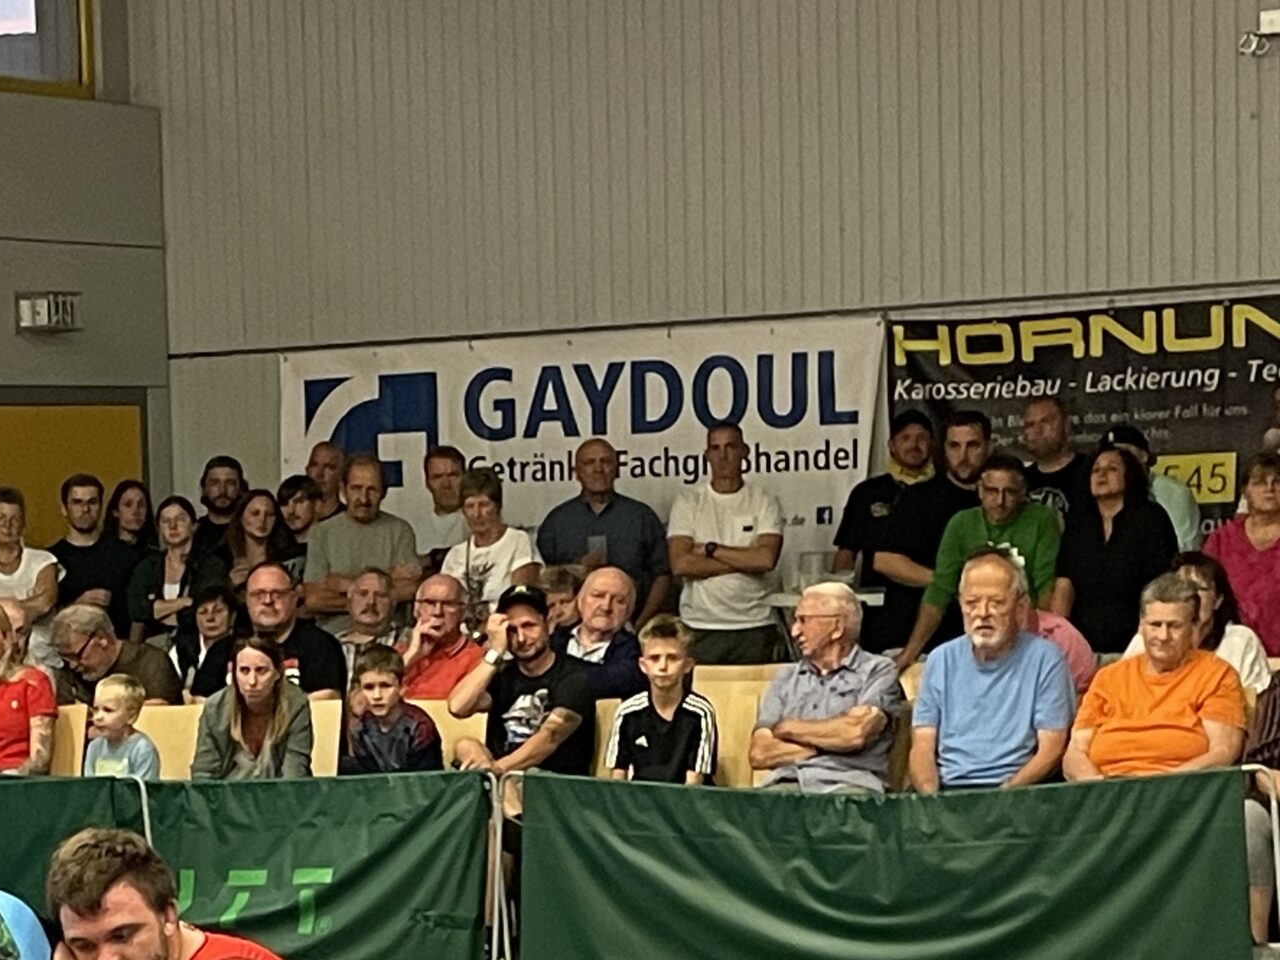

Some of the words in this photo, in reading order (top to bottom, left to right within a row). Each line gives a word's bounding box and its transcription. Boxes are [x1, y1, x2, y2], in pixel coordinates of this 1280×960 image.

[462, 349, 860, 442] GAYDOUL
[894, 374, 1062, 402] Karosseriebau
[1084, 364, 1221, 394] Lackierung
[1247, 358, 1280, 383] Te
[616, 437, 859, 485] Fachghandel
